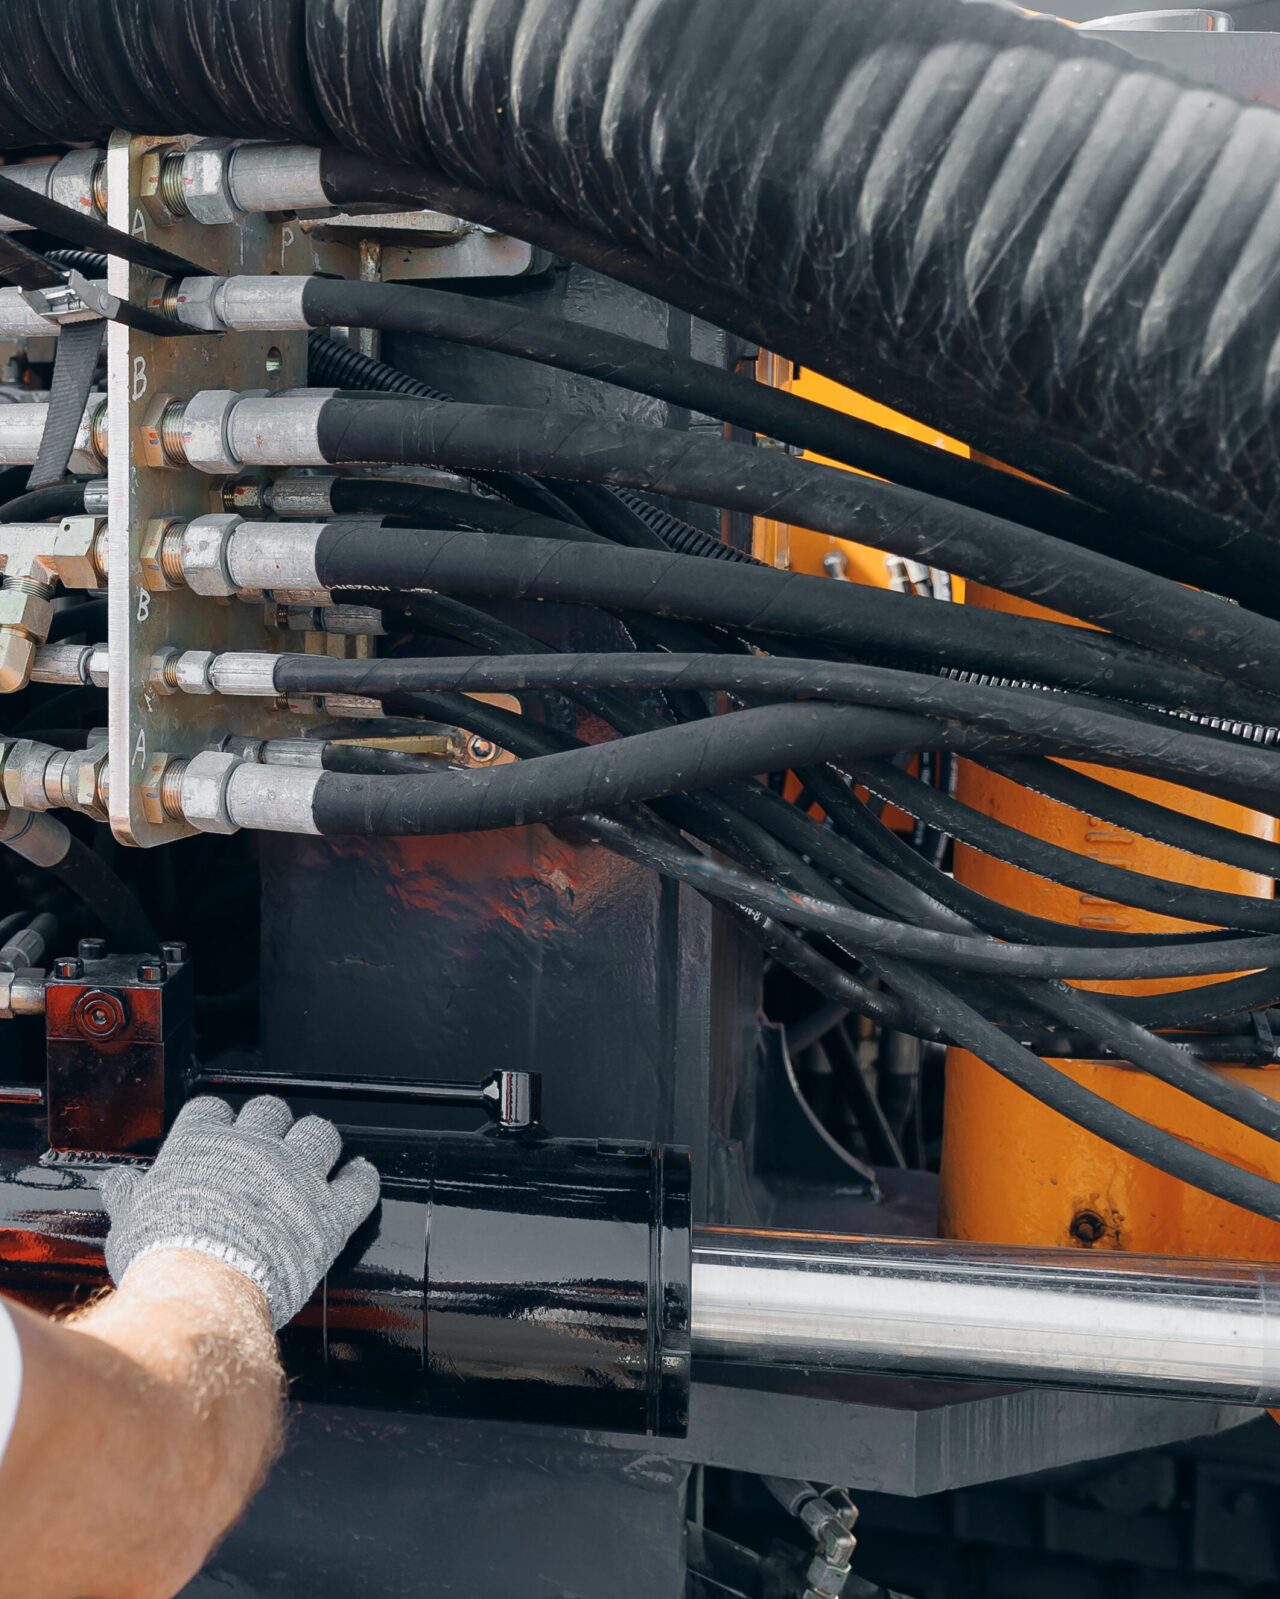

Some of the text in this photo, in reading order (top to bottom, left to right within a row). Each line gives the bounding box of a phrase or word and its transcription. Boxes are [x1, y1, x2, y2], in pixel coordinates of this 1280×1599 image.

[131, 209, 148, 242] A
[281, 227, 295, 269] P
[132, 356, 148, 401] B
[136, 587, 151, 621] B
[131, 729, 146, 770] A
